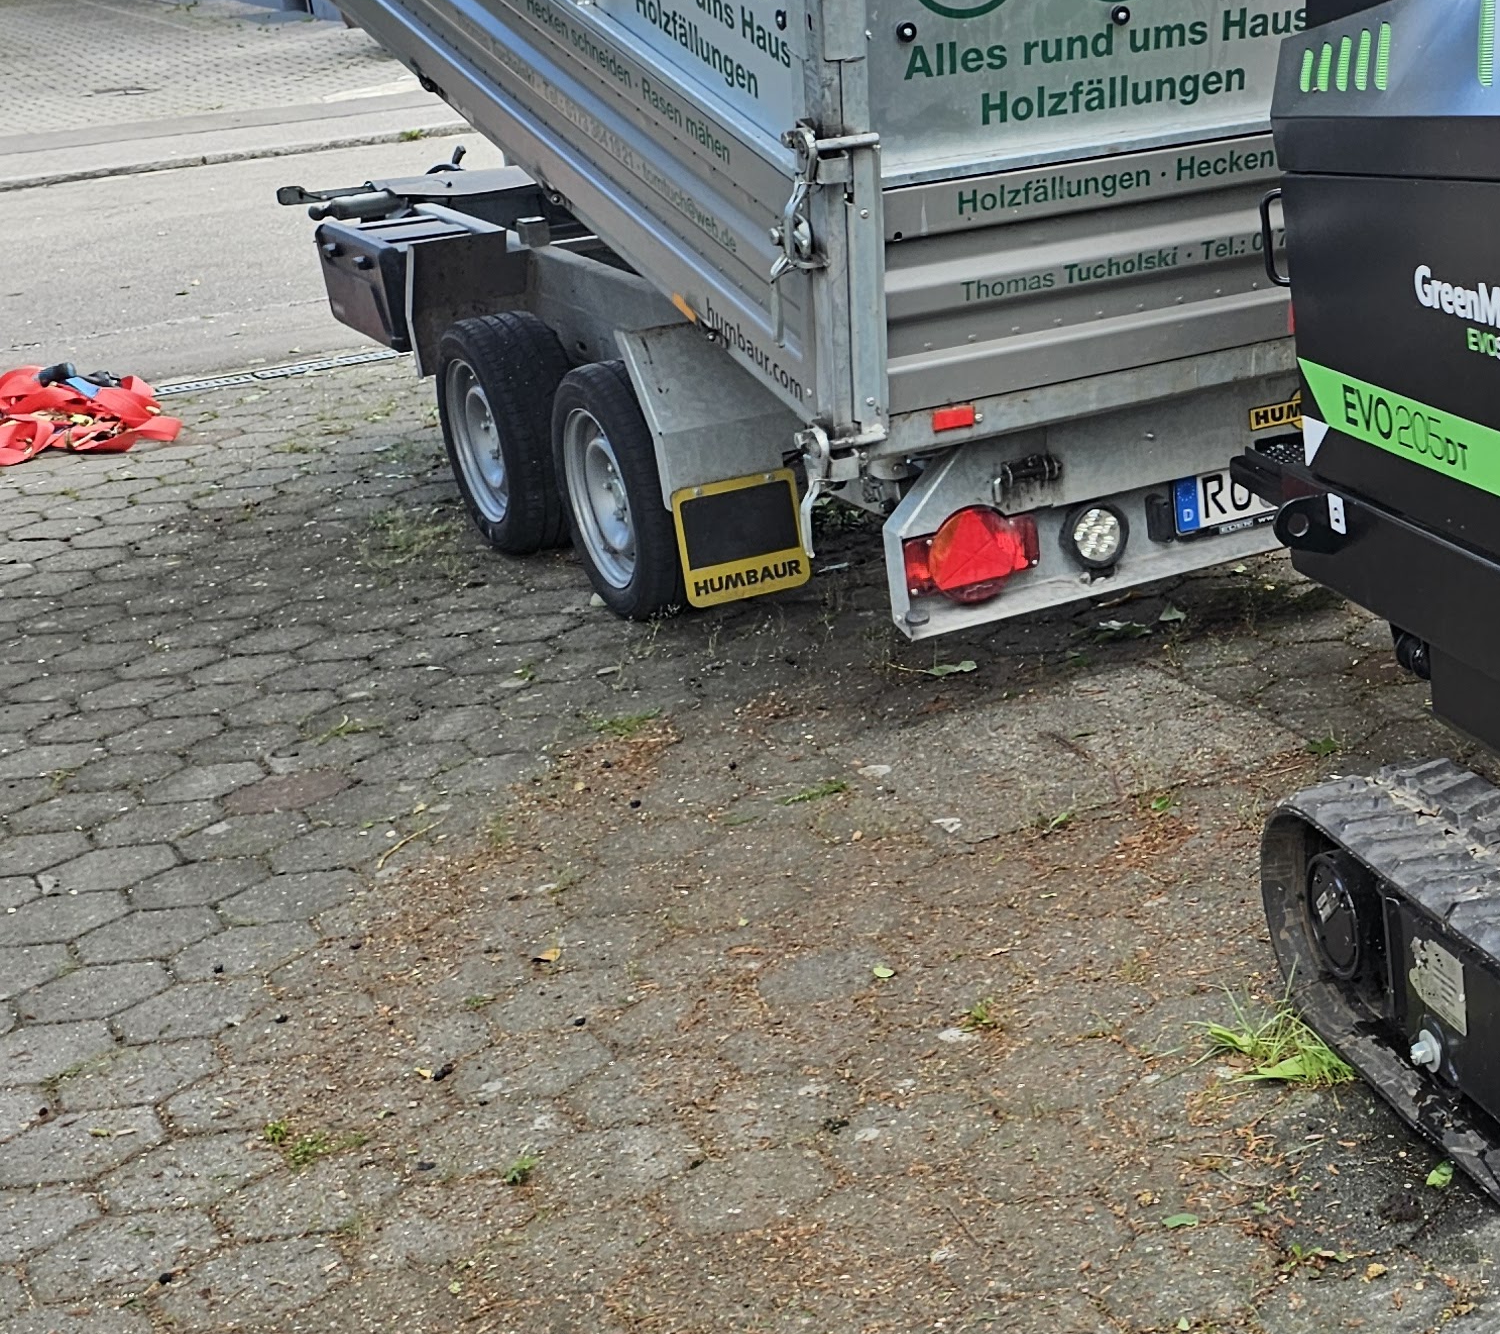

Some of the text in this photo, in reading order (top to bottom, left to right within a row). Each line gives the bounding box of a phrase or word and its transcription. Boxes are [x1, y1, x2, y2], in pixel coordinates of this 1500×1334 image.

[740, 5, 791, 68] Haus
[904, 5, 1308, 81] Alles rund ums Haus
[570, 28, 632, 88] schneiden
[642, 77, 683, 128] Rasen
[685, 116, 731, 165] mähen
[980, 67, 1246, 127] Holzfällungen
[957, 167, 1151, 216] Holzfällungen
[1175, 147, 1276, 182] Hecken
[960, 272, 1055, 302] Thomas
[1063, 246, 1180, 285] Tucholski
[1201, 236, 1245, 260] Tel.:
[706, 297, 803, 401] humbaur.com
[1183, 508, 1194, 522] D
[694, 559, 802, 597] HUMBAUR
